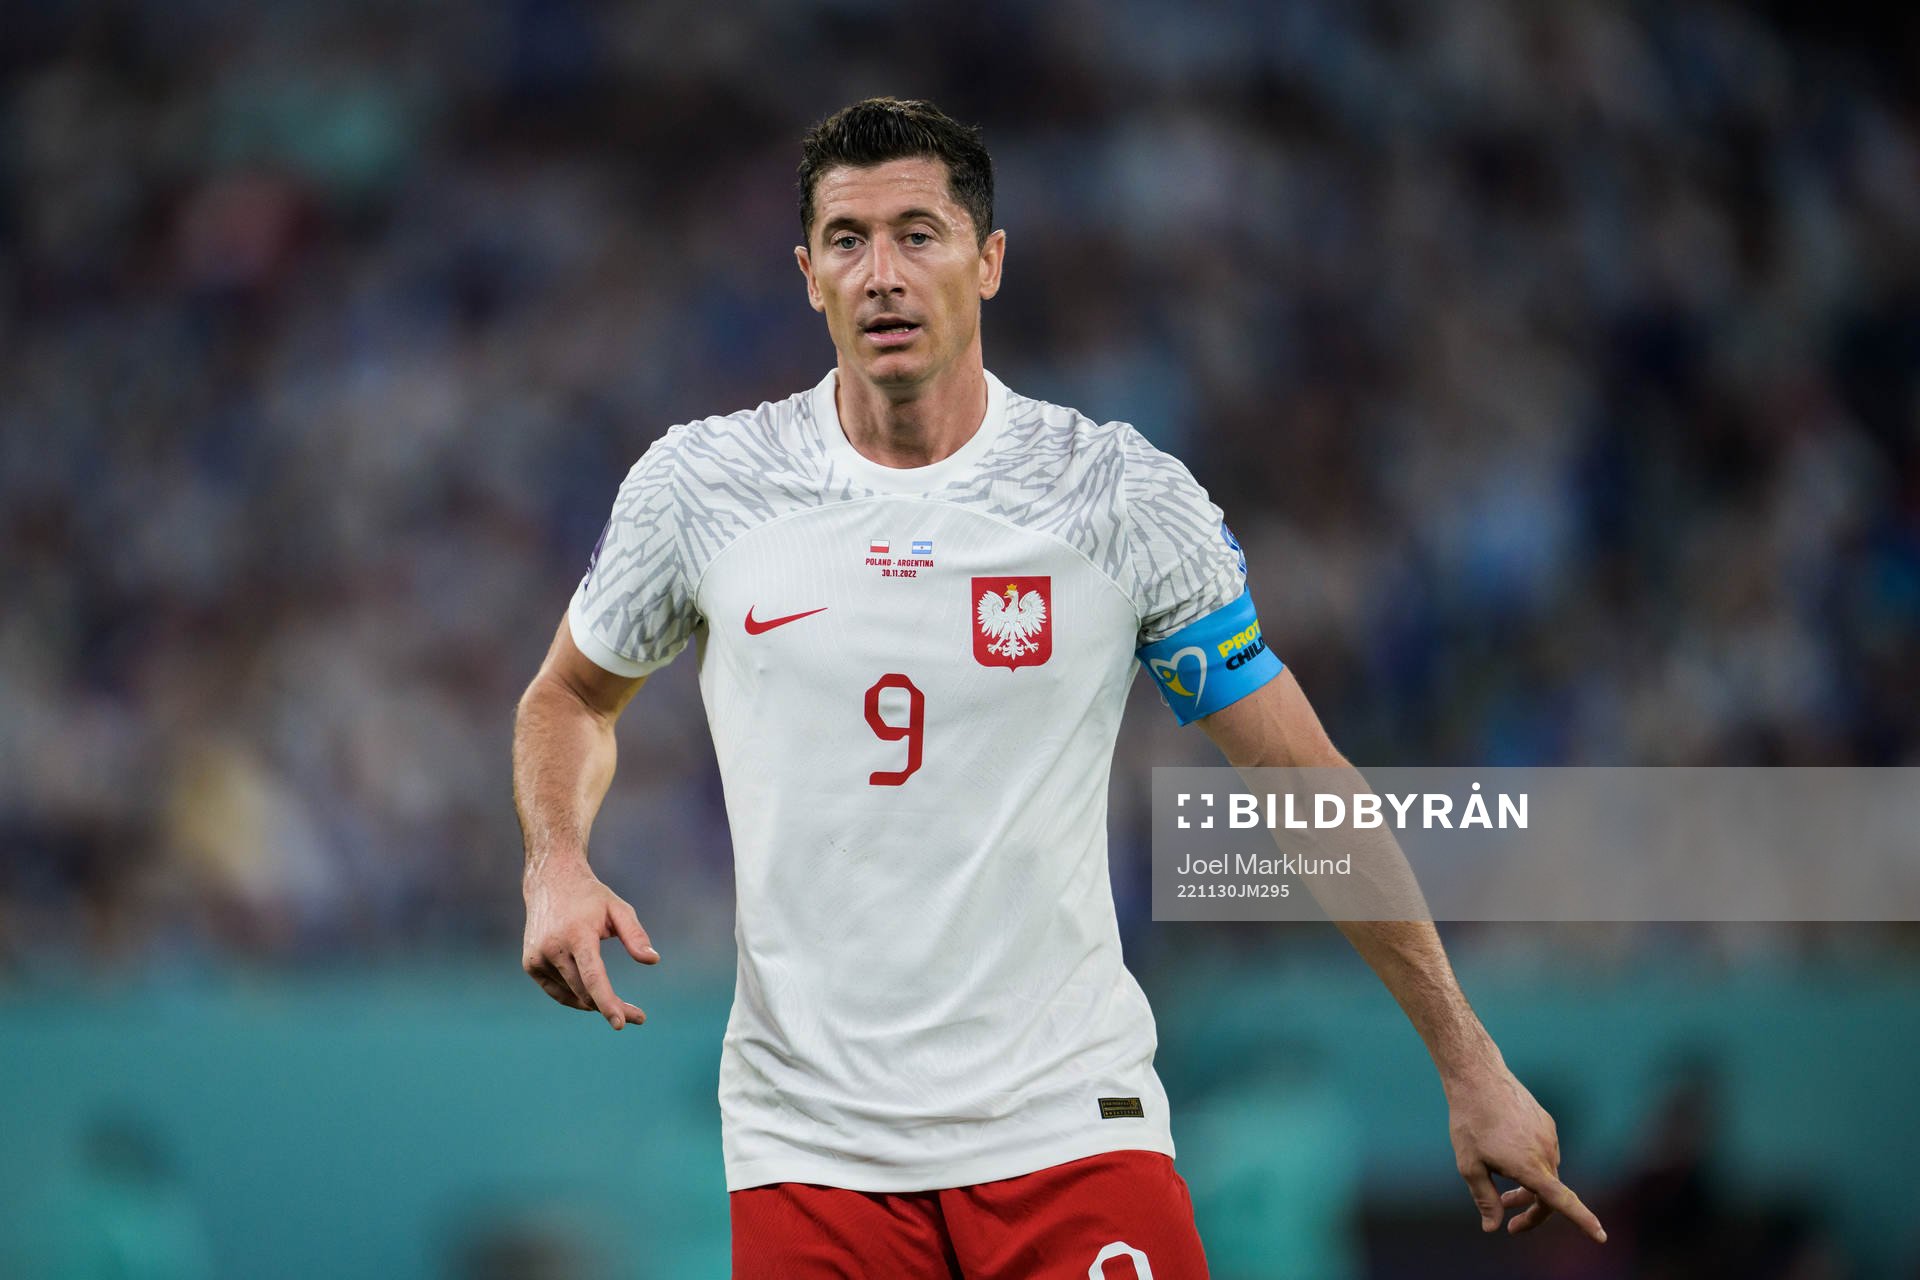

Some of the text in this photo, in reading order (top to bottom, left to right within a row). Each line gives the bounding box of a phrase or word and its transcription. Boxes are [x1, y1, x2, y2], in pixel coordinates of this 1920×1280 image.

[865, 558, 891, 567] POLAND
[897, 559, 934, 568] ARGENTINA
[881, 569, 917, 578] 30.11.2022
[864, 673, 925, 786] 9
